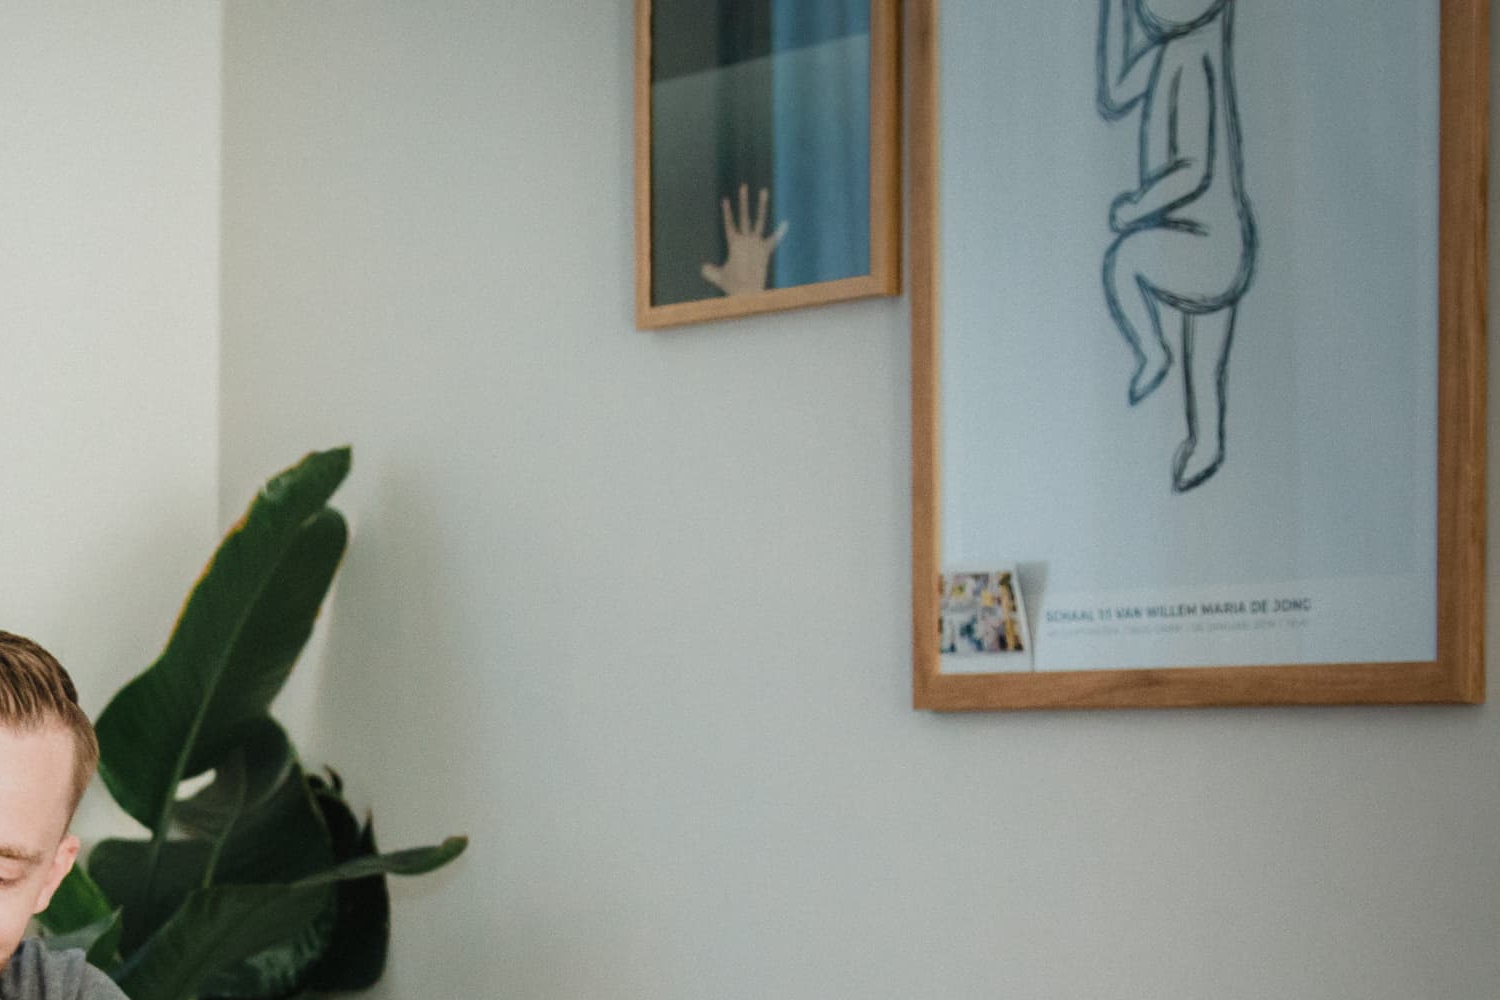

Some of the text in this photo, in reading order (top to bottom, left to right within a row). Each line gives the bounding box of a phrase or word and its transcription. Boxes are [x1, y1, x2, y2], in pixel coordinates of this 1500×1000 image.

[1116, 606, 1142, 620] VAN
[1147, 603, 1198, 618] WILLEM
[1202, 601, 1247, 615] MARIA
[1250, 599, 1268, 614] DE
[1273, 597, 1312, 612] JONG
